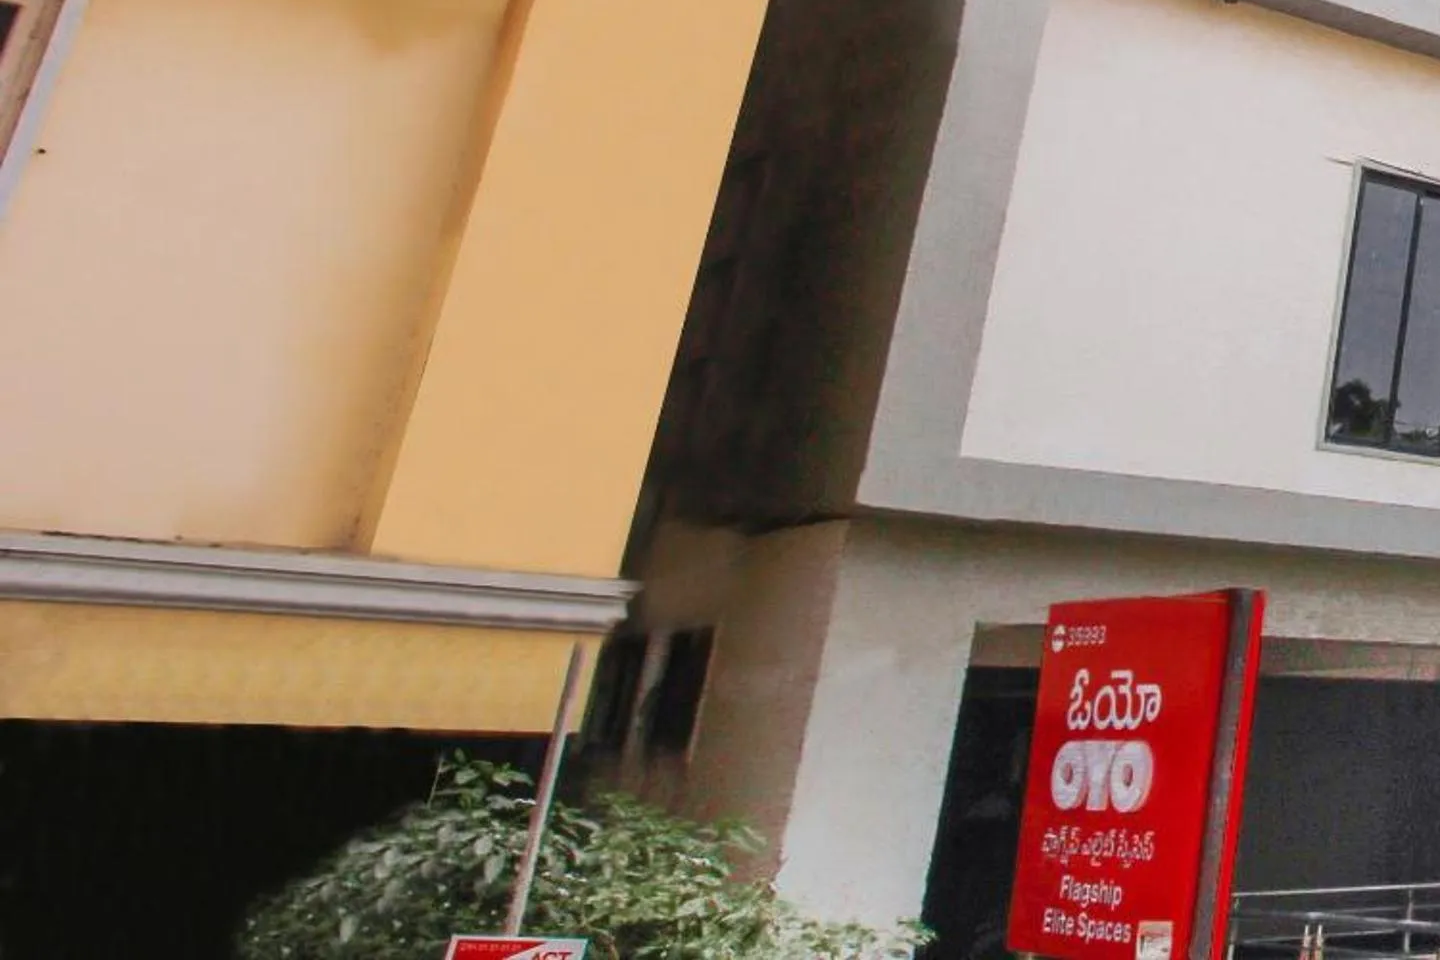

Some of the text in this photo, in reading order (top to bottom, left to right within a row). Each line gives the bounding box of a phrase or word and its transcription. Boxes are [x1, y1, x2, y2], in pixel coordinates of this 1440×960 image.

[1051, 739, 1154, 813] OYO
[1060, 874, 1122, 911] Flagship
[1043, 907, 1132, 944] Elite Spaces
